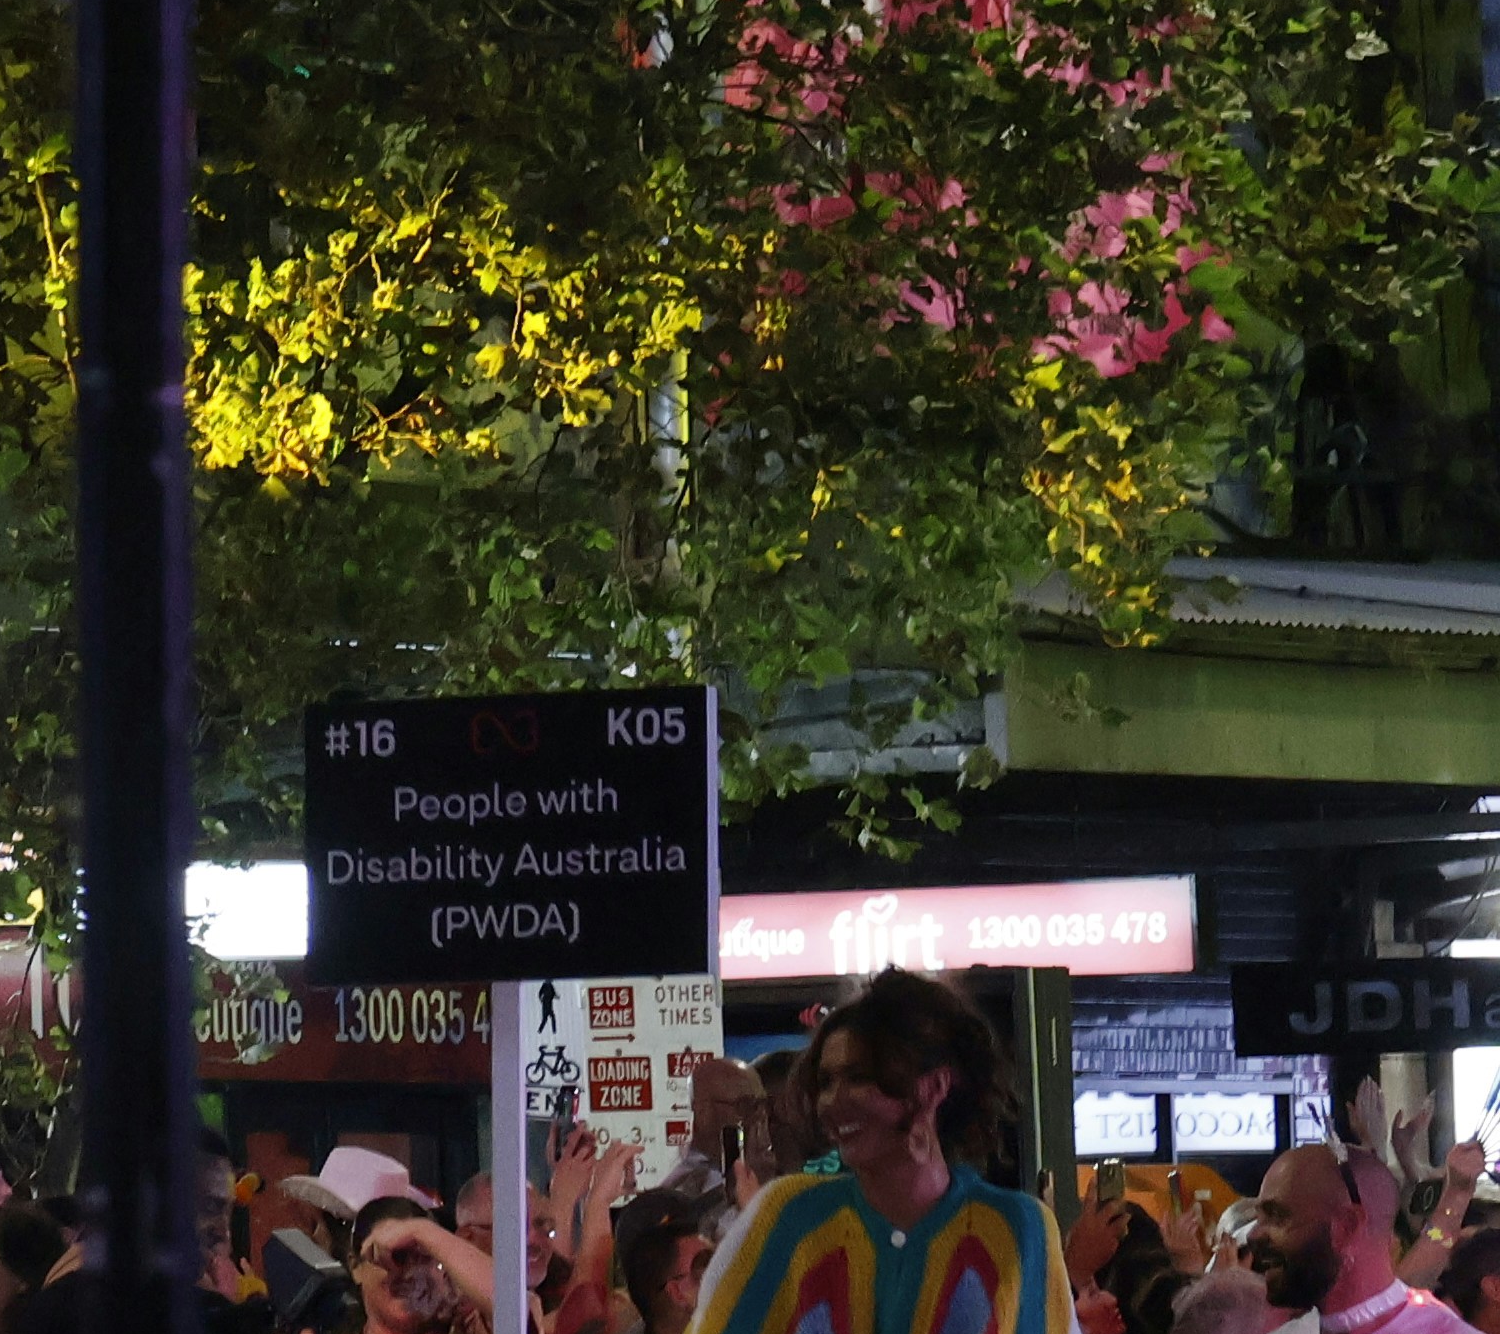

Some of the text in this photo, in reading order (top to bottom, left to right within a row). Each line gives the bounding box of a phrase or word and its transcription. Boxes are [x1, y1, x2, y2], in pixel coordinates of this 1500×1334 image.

[324, 707, 686, 757] #16 K05
[394, 778, 619, 826] People with
[327, 837, 687, 889] Disability Australia
[431, 901, 580, 948] (PWDA)
[828, 893, 946, 977] flirt
[968, 915, 1042, 950] 1300
[1046, 912, 1106, 947] 035
[1110, 910, 1168, 944] 478
[593, 990, 630, 1007] BUS
[654, 984, 715, 1003] OTHER
[334, 988, 405, 1044] 1300
[412, 988, 466, 1044] 035
[592, 1009, 634, 1027] ZONE
[658, 1008, 713, 1025] TIMES
[591, 1060, 649, 1081] LOADING
[600, 1085, 643, 1107] ZONE
